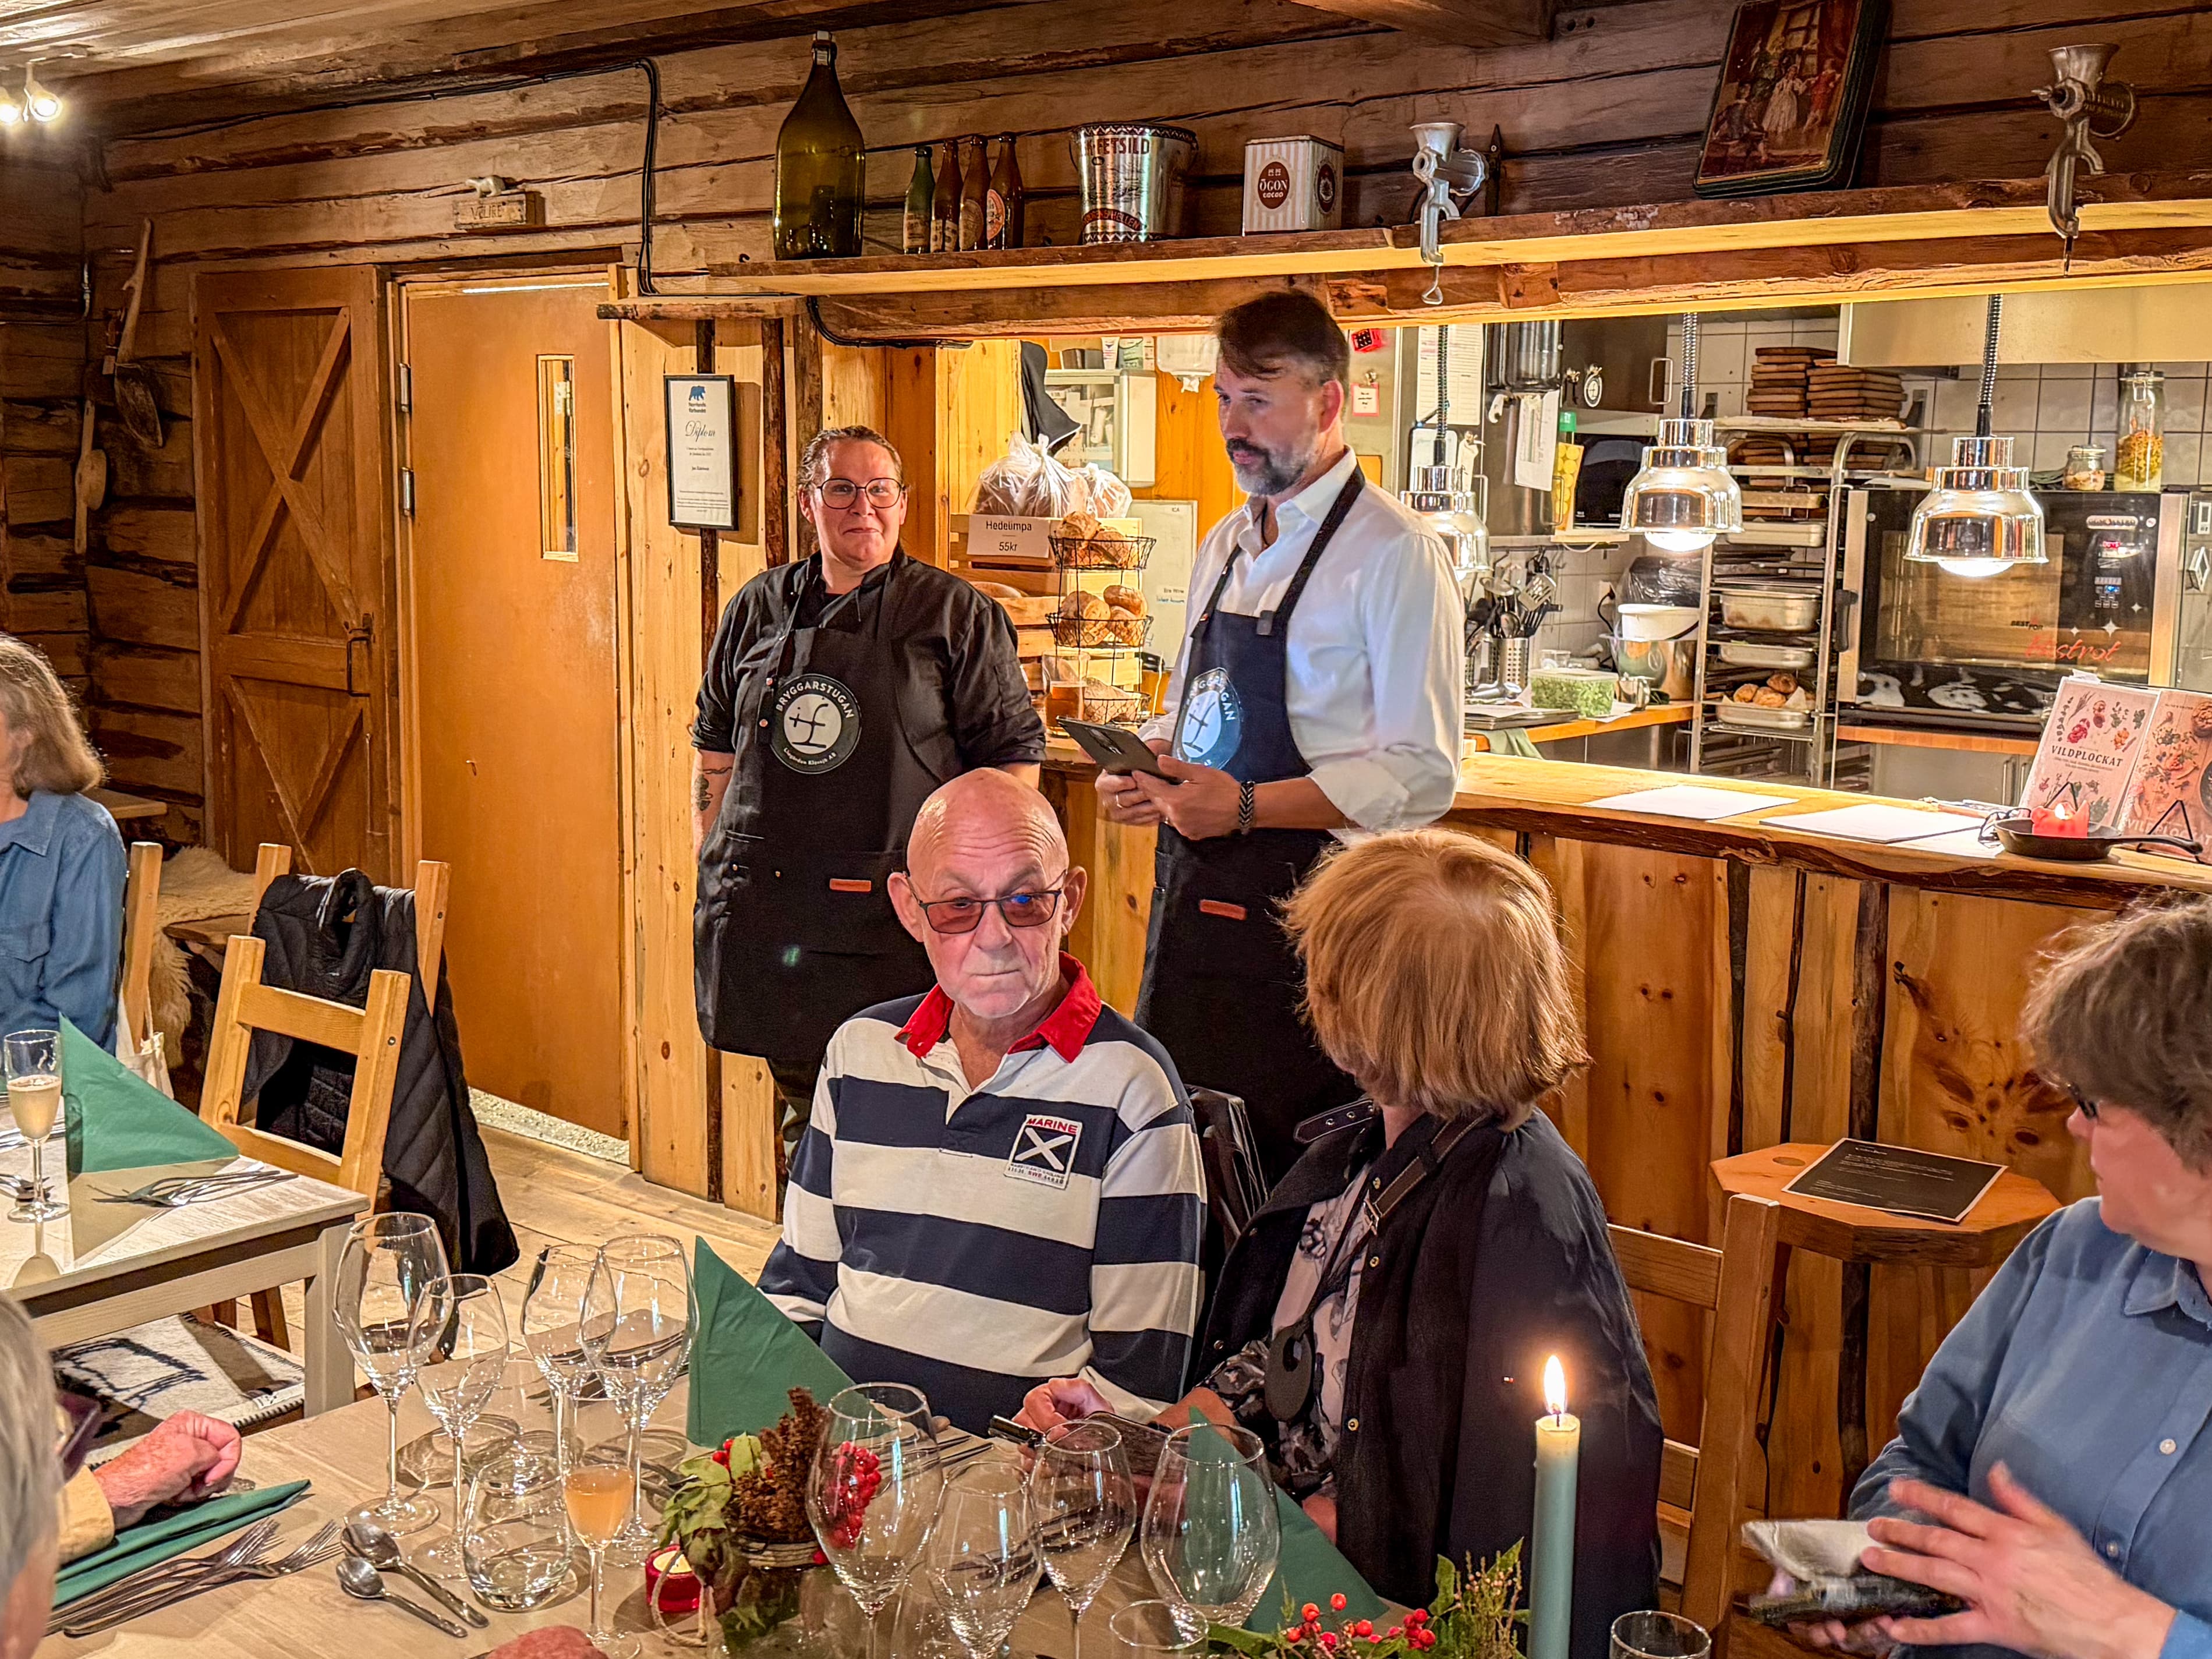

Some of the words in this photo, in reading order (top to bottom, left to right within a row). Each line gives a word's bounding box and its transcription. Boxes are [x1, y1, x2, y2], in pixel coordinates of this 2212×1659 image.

[986, 521, 1032, 533] Hedelimpa
[999, 542, 1018, 551] 55kr
[776, 681, 855, 719] BRYGGARSTUGAN
[2051, 745, 2123, 767] VILDPLOCKAT
[1027, 1118, 1078, 1135] MARINE
